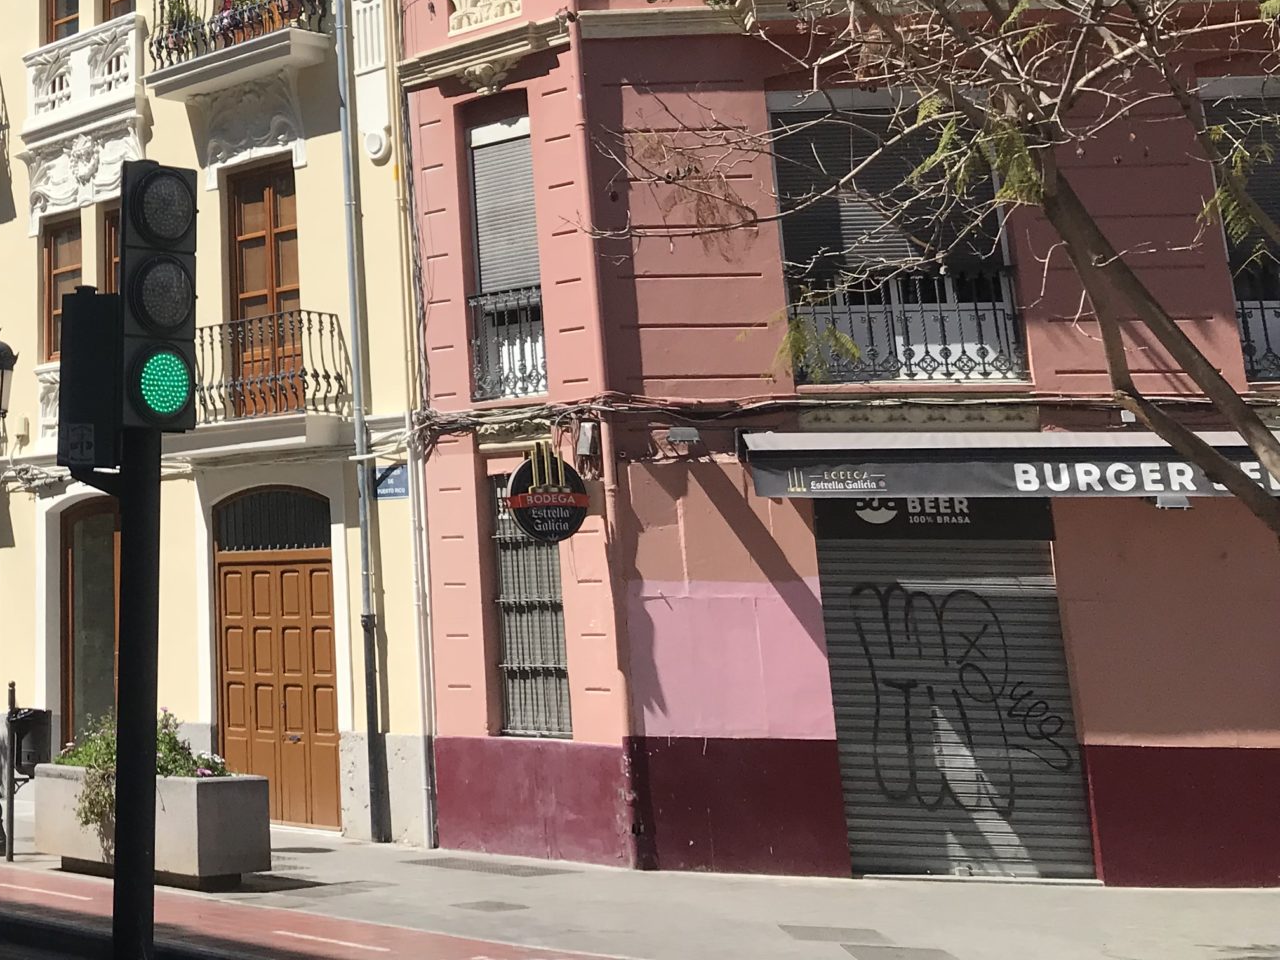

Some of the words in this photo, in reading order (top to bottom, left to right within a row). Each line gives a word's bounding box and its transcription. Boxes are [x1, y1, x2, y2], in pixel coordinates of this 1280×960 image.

[1013, 462, 1197, 492] BURGER
[810, 480, 844, 490] Estrella
[845, 479, 877, 489] Galicia
[377, 487, 394, 495] PUERTO
[526, 494, 575, 505] BODEGA
[907, 497, 970, 513] BEER
[531, 507, 570, 518] Estrella
[936, 515, 971, 524] BRASA
[533, 520, 570, 531] Galicia
